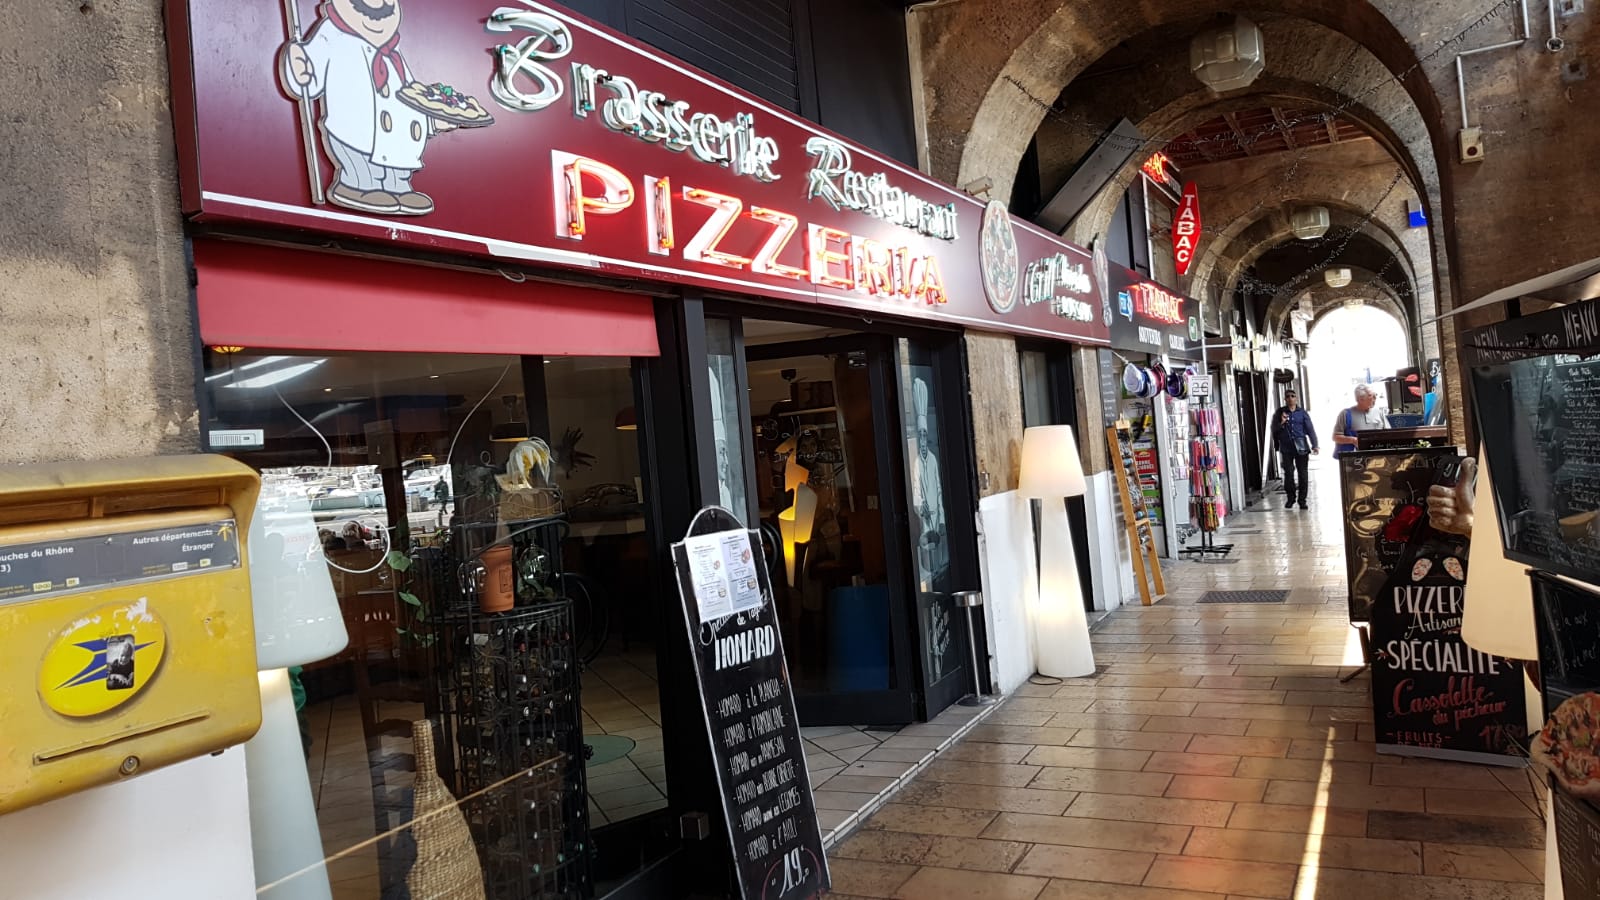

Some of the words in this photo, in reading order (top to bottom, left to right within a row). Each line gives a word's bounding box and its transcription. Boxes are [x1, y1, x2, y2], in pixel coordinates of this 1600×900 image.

[485, 7, 782, 182] Brasserie
[806, 137, 959, 242] Restaurant
[551, 149, 947, 305] PIZZERIA
[1176, 194, 1195, 262] TABAC
[1562, 303, 1598, 347] MENU
[133, 536, 159, 545] Autres
[161, 528, 213, 543] départements
[182, 542, 214, 552] Étranger
[31, 549, 43, 558] du
[45, 546, 74, 556] Rhône
[715, 625, 775, 671] HOMARD
[718, 693, 742, 718] HOMARD
[757, 678, 781, 703] PLANCHA
[1389, 676, 1490, 717] Cassolette
[1433, 710, 1448, 726] du
[724, 722, 746, 748] HOMARD
[1396, 731, 1442, 744] FRUITS
[729, 751, 750, 776] HOMARD
[735, 780, 757, 805] HOMARD
[741, 806, 762, 832] HOMARD
[747, 834, 769, 862] HOMARD
